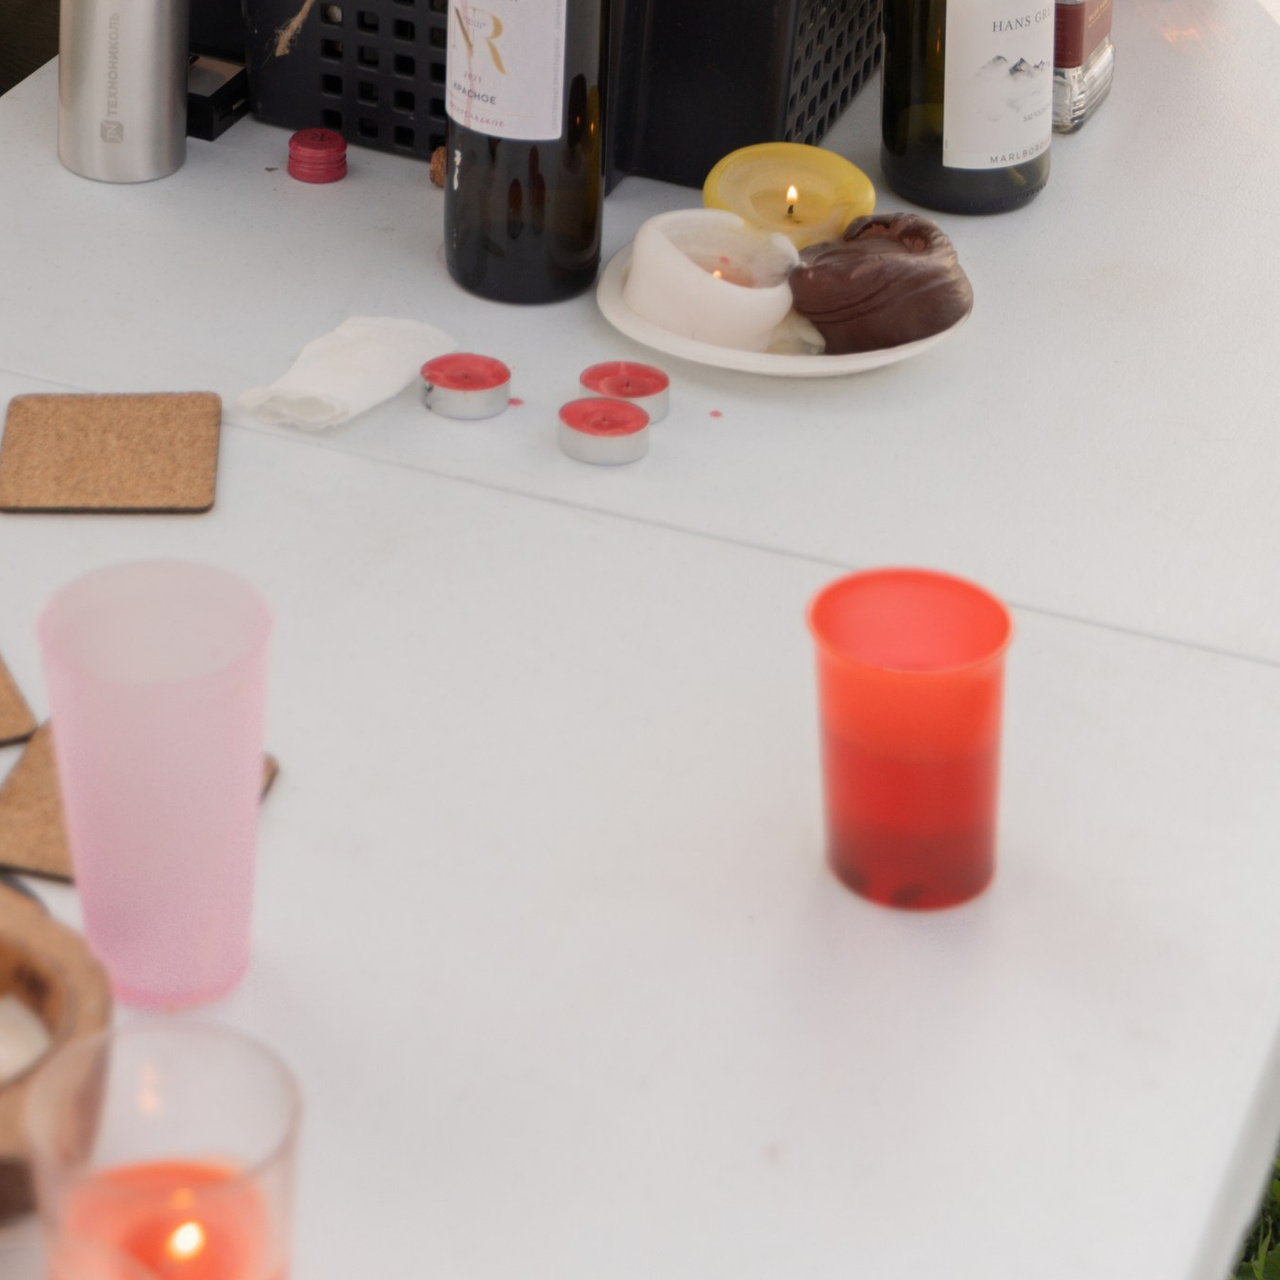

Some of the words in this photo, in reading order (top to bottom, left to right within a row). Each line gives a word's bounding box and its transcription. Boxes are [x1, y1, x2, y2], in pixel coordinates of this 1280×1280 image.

[992, 15, 1031, 33] HANS
[106, 12, 120, 117] ТЕХНОНИКОЛЬ
[453, 81, 497, 106] КРАСНОЕ
